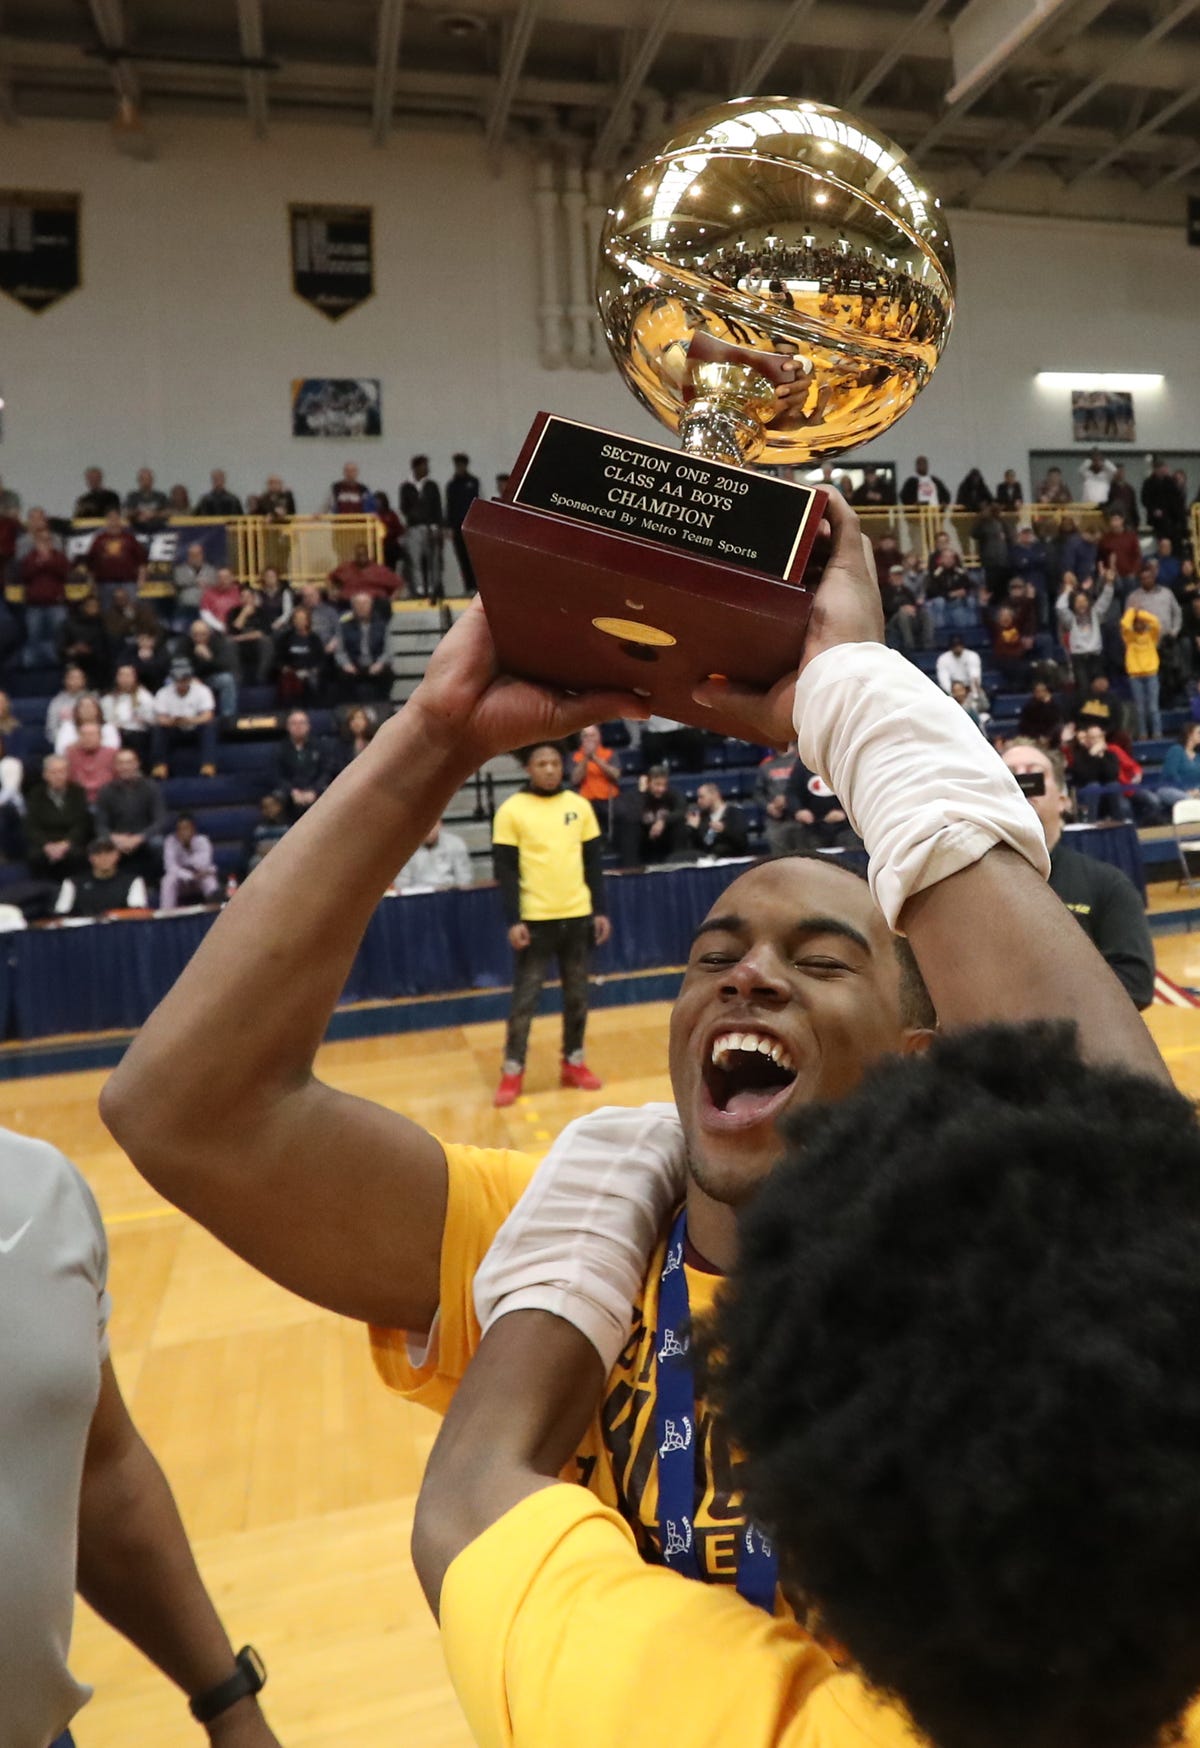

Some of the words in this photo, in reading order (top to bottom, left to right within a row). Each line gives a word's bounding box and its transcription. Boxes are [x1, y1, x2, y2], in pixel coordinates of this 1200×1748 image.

[600, 444, 671, 474] SECTION
[675, 465, 711, 485] ONE
[714, 476, 749, 496] 2019
[603, 465, 655, 489] CLASS
[658, 482, 683, 498] AA
[690, 489, 733, 511] BOYS
[550, 492, 616, 519] Sponsored
[619, 512, 637, 526] By
[641, 518, 676, 536] Metro
[681, 529, 713, 547] Team
[717, 540, 757, 559] Sports
[607, 487, 716, 529] CHAMPION
[564, 811, 579, 826] P
